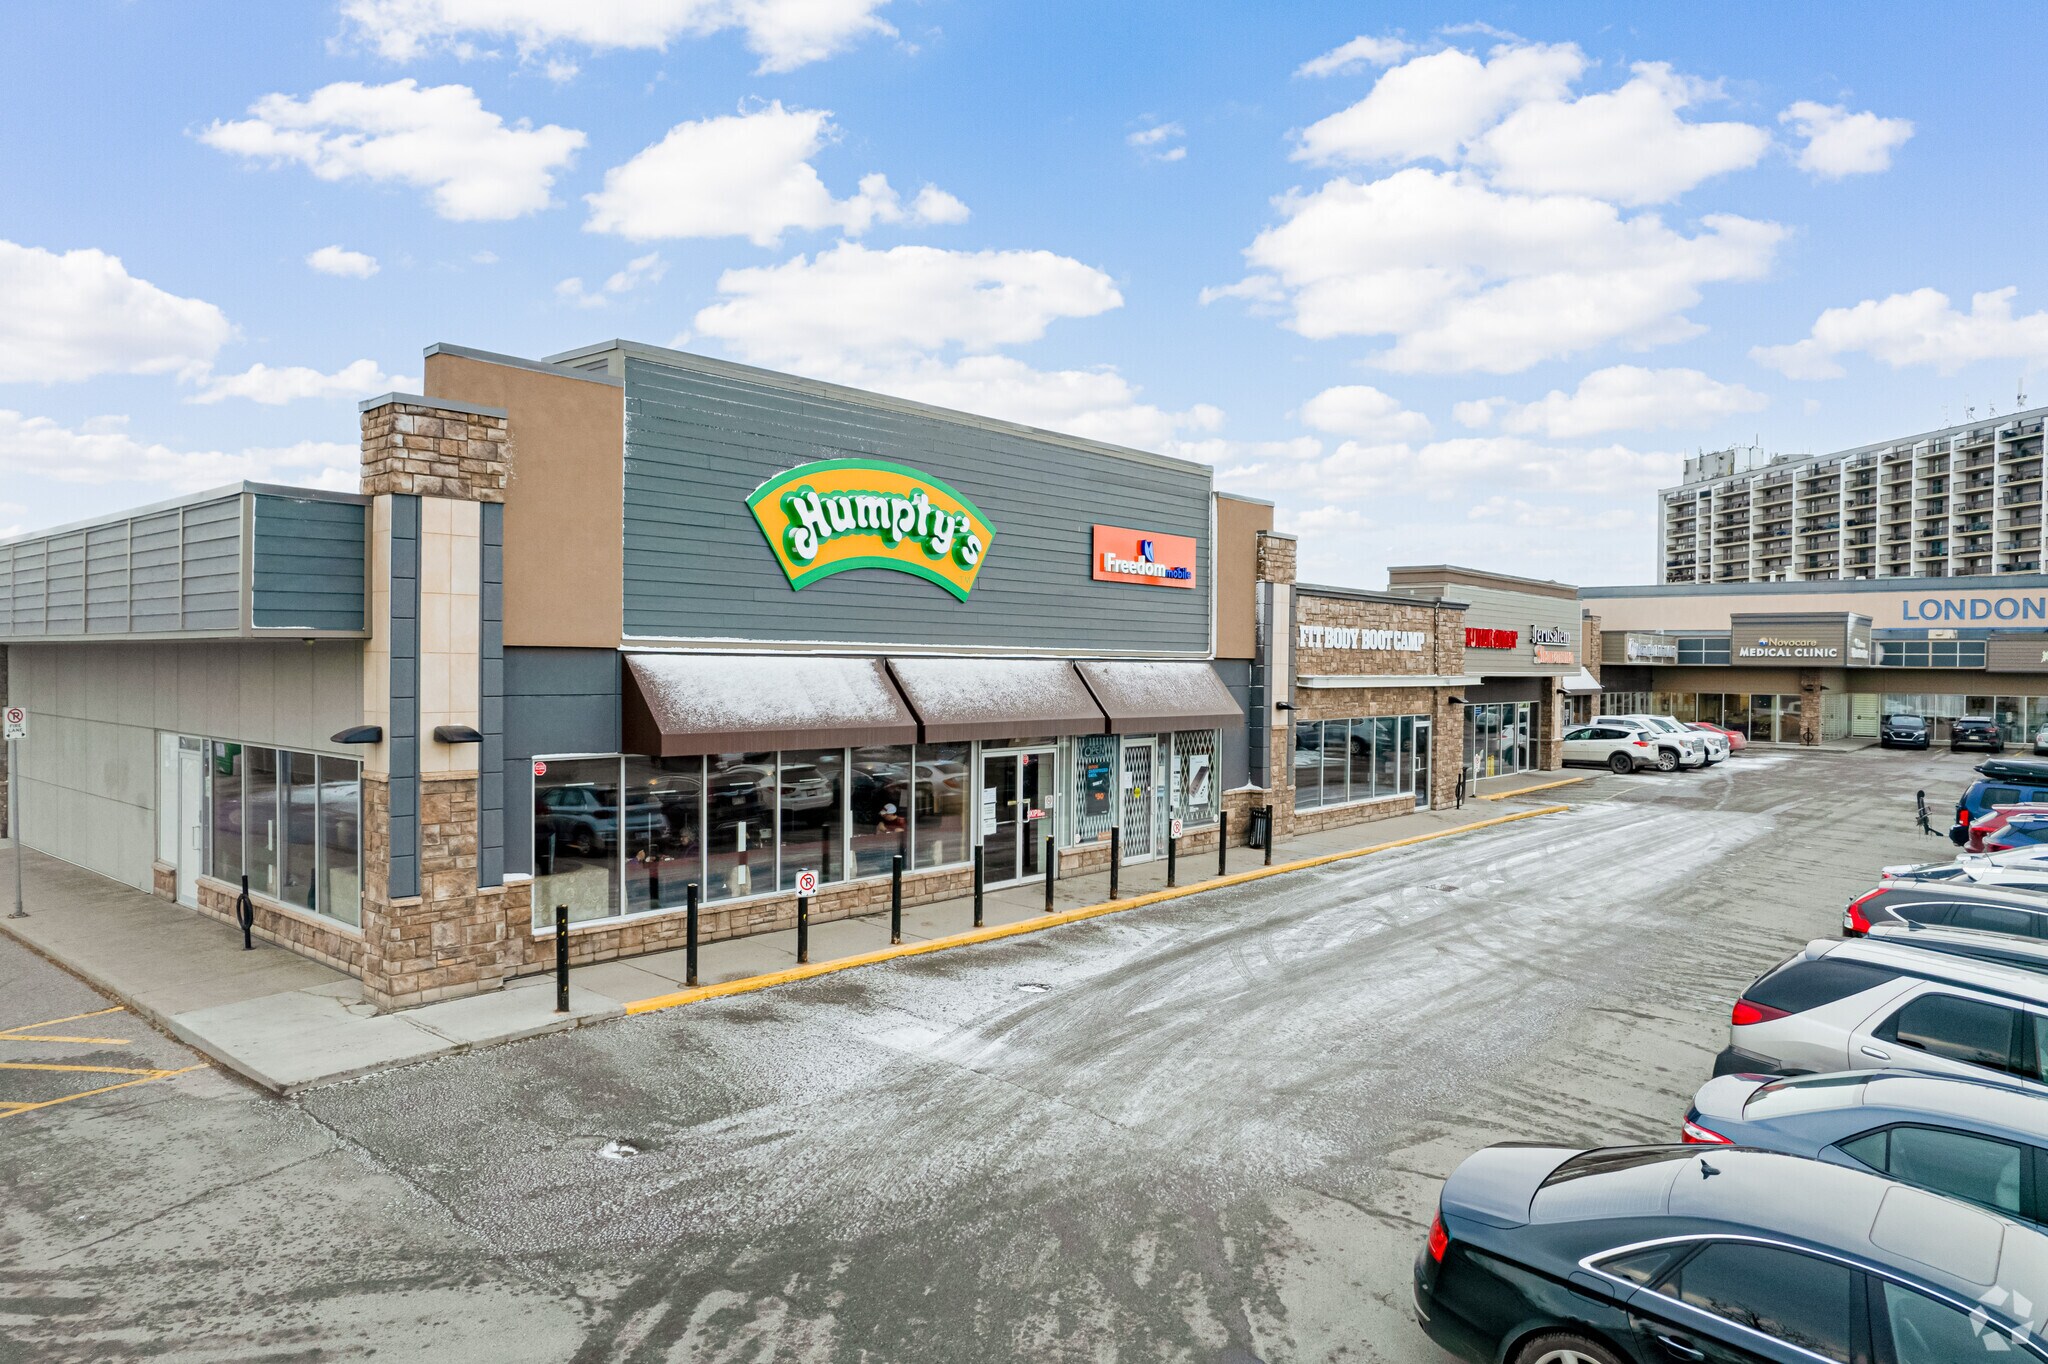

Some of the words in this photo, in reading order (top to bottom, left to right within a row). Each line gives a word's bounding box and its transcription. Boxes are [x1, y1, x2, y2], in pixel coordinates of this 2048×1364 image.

[789, 490, 982, 566] Humpty's
[1103, 552, 1166, 578] Freedom
[1165, 566, 1191, 580] mobile
[1903, 597, 2046, 621] LONDON
[1299, 625, 1324, 648] FIT
[1324, 626, 1359, 649] BODY
[1361, 628, 1393, 650] BOOT
[1393, 630, 1425, 652] CAMP
[1531, 624, 1570, 644] Jerusalem
[1768, 637, 1817, 647] Novocare
[1739, 647, 1792, 657] MEDICAL
[1794, 647, 1838, 658] CLINIC
